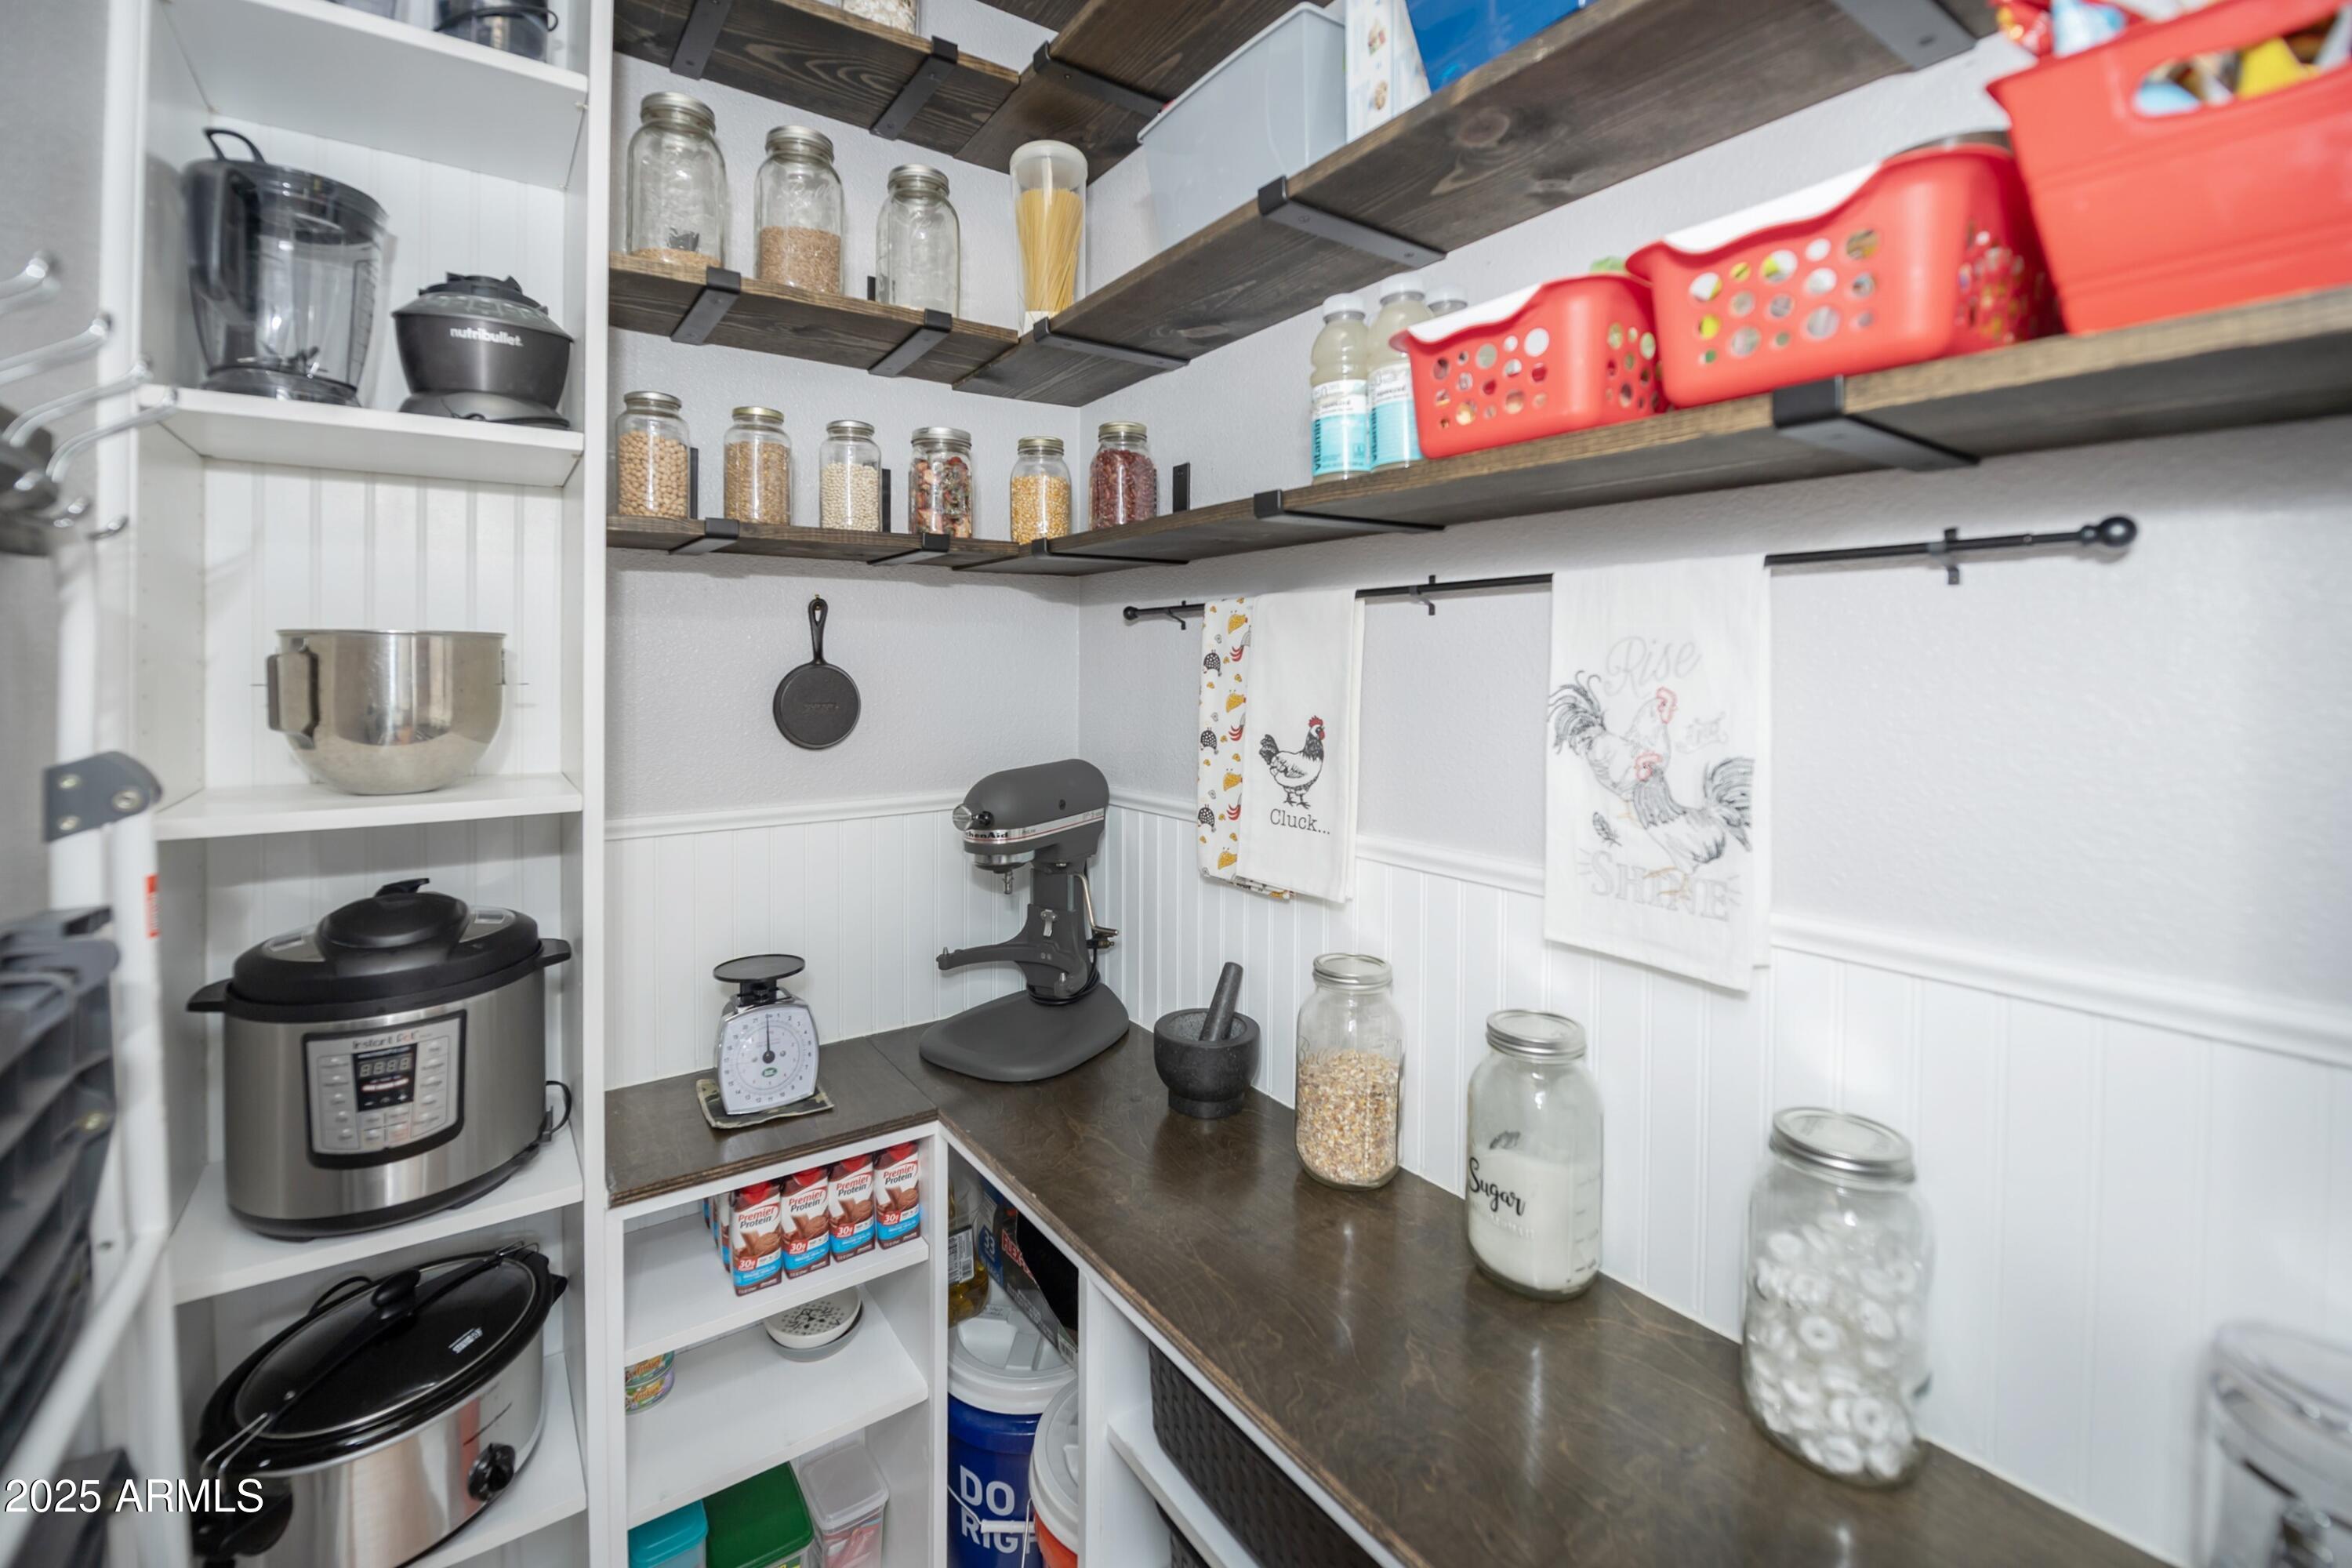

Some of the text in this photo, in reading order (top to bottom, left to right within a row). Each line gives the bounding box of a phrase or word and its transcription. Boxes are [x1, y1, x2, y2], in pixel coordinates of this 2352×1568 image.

[450, 328, 521, 346] nutribullet
[1603, 635, 1703, 699] Rise
[1270, 808, 1330, 834] Cluck...
[1591, 850, 1730, 922] SHINE
[884, 1165, 915, 1178] Premier
[885, 1172, 913, 1185] Protein
[837, 1176, 869, 1190] Premier
[838, 1184, 866, 1196] Protein
[1468, 1156, 1526, 1216] Sugar
[789, 1190, 823, 1206] Premier
[790, 1199, 821, 1212] Protein
[738, 1207, 775, 1221] Premier
[740, 1215, 772, 1229] Protein
[984, 1229, 996, 1255] 33
[960, 1465, 1015, 1516] DO
[961, 1504, 1039, 1555] RIG
